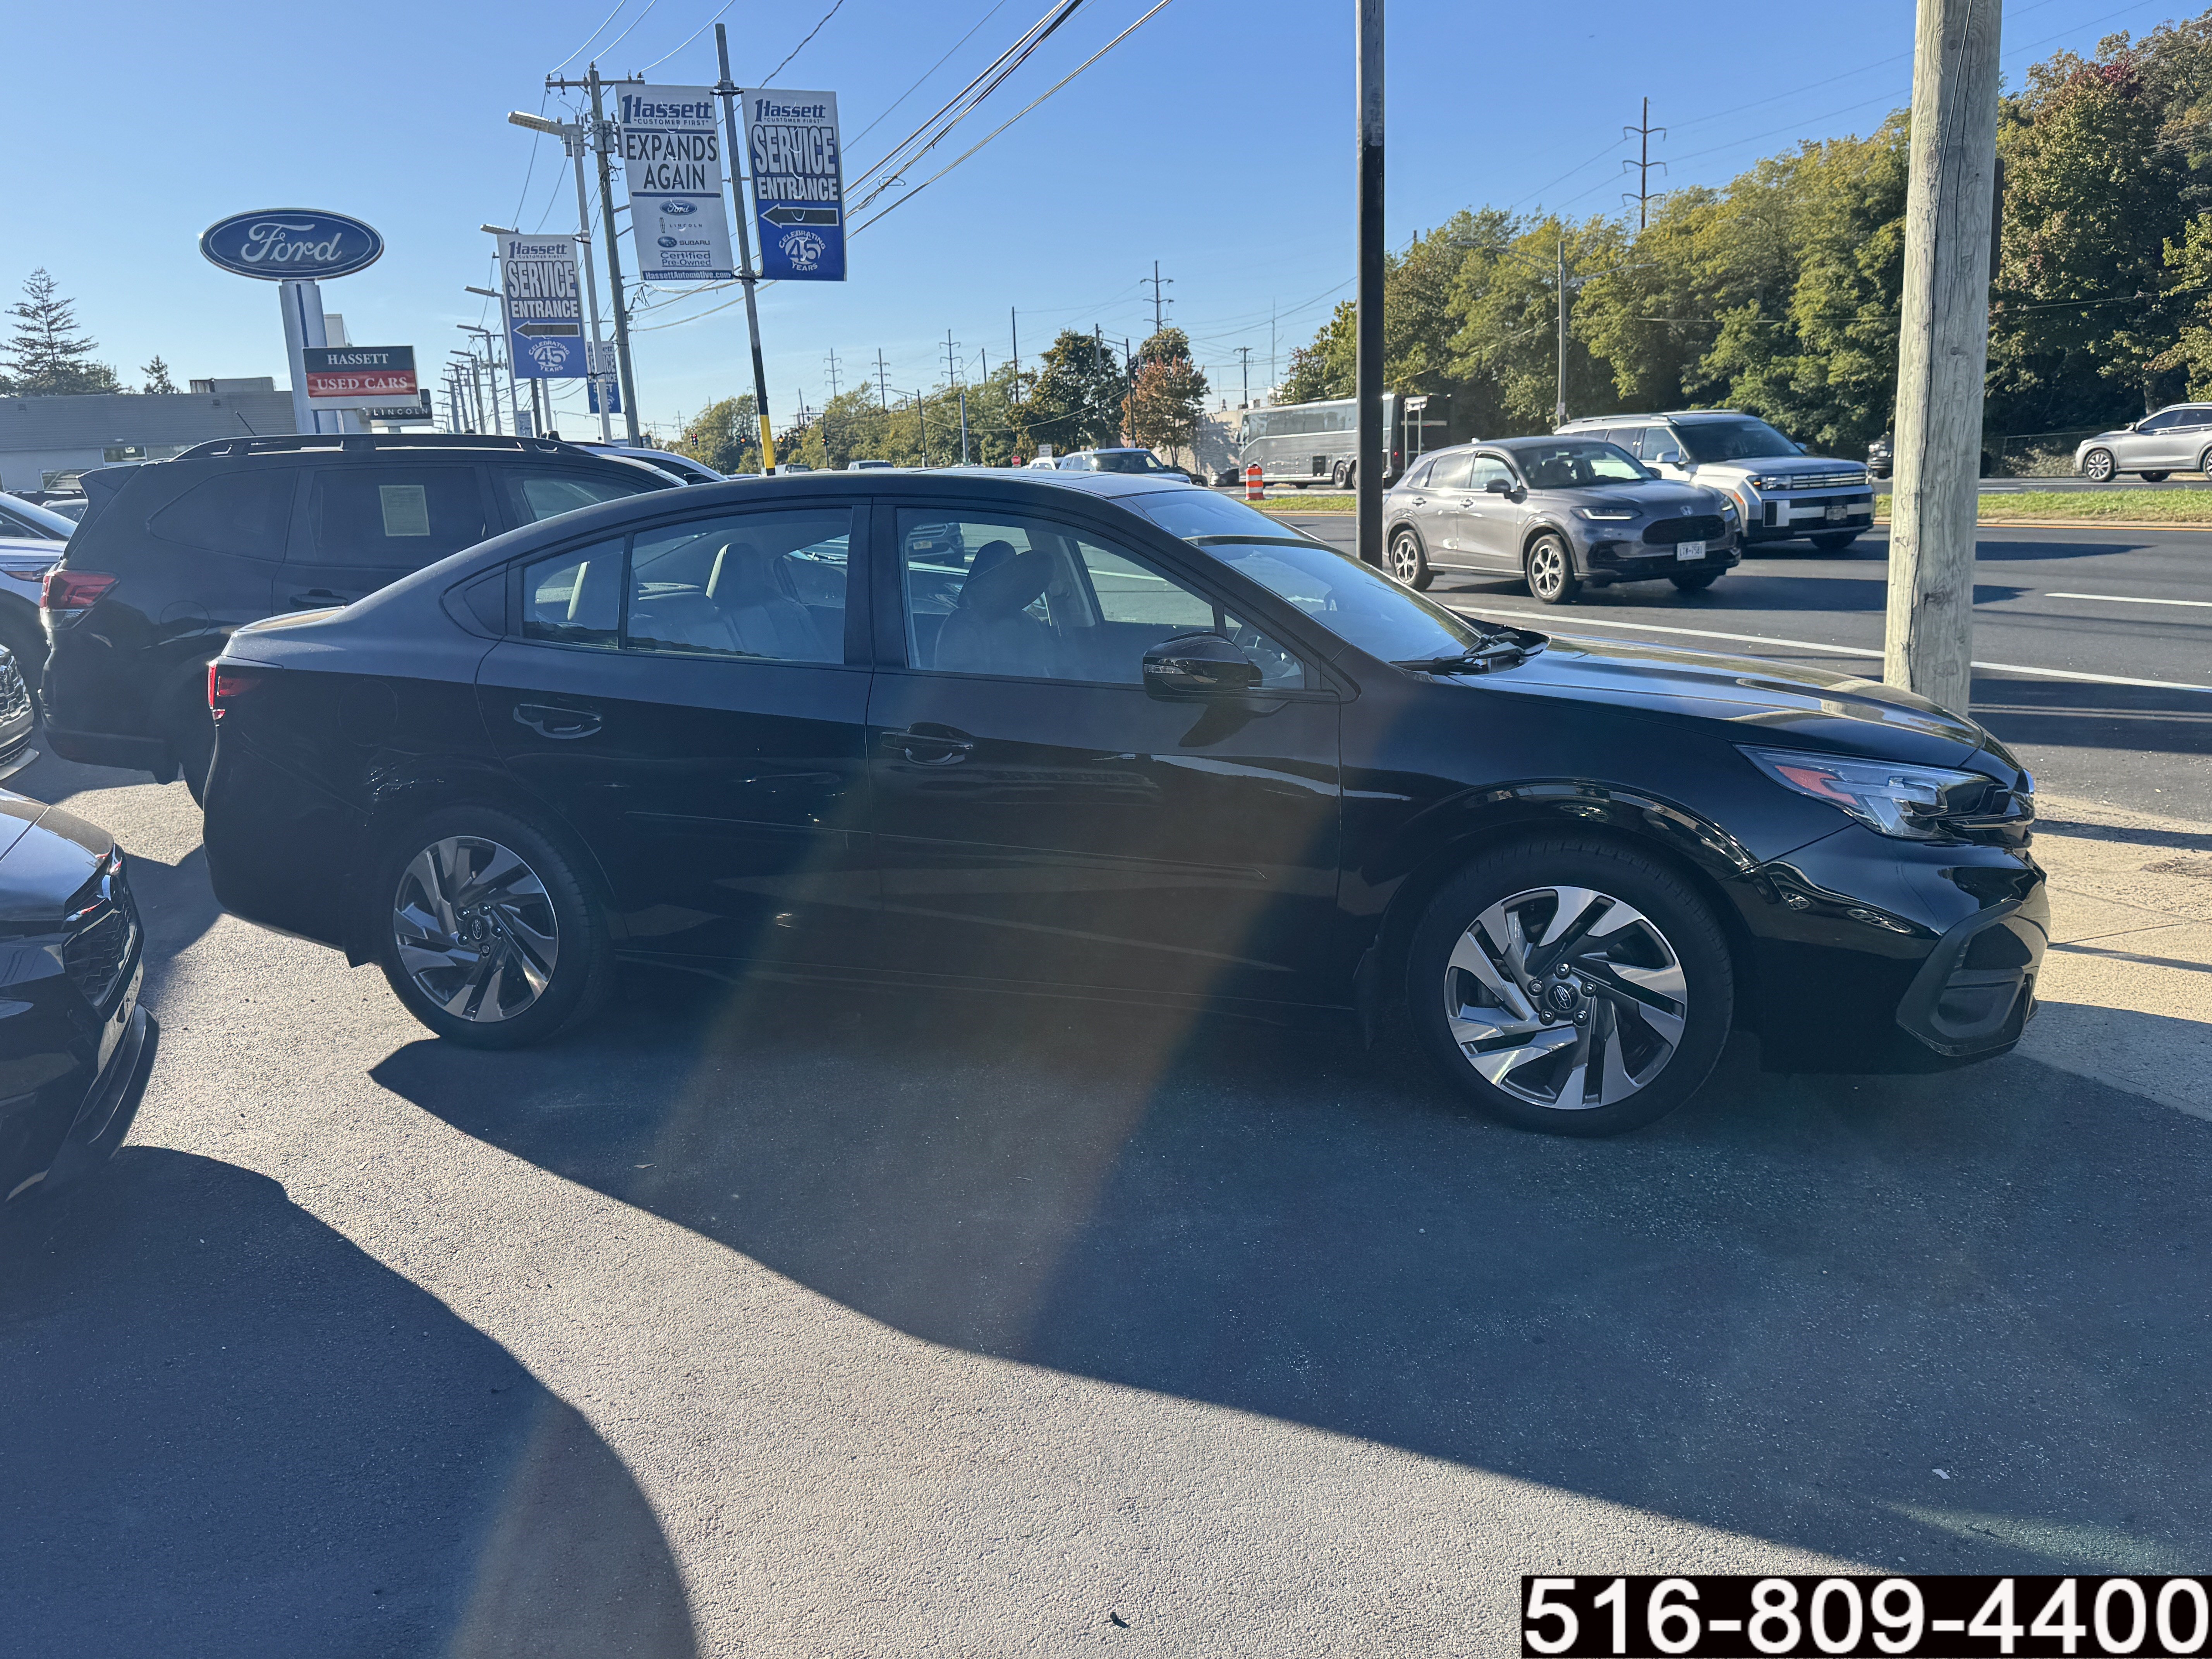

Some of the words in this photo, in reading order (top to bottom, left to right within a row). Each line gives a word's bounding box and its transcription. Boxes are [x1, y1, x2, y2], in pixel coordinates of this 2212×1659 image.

[626, 134, 717, 161] EXPANDS
[752, 124, 836, 174] SERVICE
[644, 163, 705, 190] AGAIN
[757, 176, 838, 201] ENTRANCE
[667, 202, 690, 212] Ford
[241, 222, 342, 263] Ford
[778, 230, 826, 250] CELEBRATING
[787, 239, 818, 262] 45
[792, 261, 818, 271] YEARS
[506, 260, 576, 298] SERVICE
[645, 271, 731, 280] HassettAutomotive.com
[510, 300, 579, 318] ENTRANCE
[528, 340, 570, 356] CELEBRATING
[536, 348, 564, 365] 45
[327, 353, 389, 365] HASSETT
[317, 378, 359, 390] USED
[364, 377, 407, 388] CARS
[373, 408, 428, 416] LINCOLN
